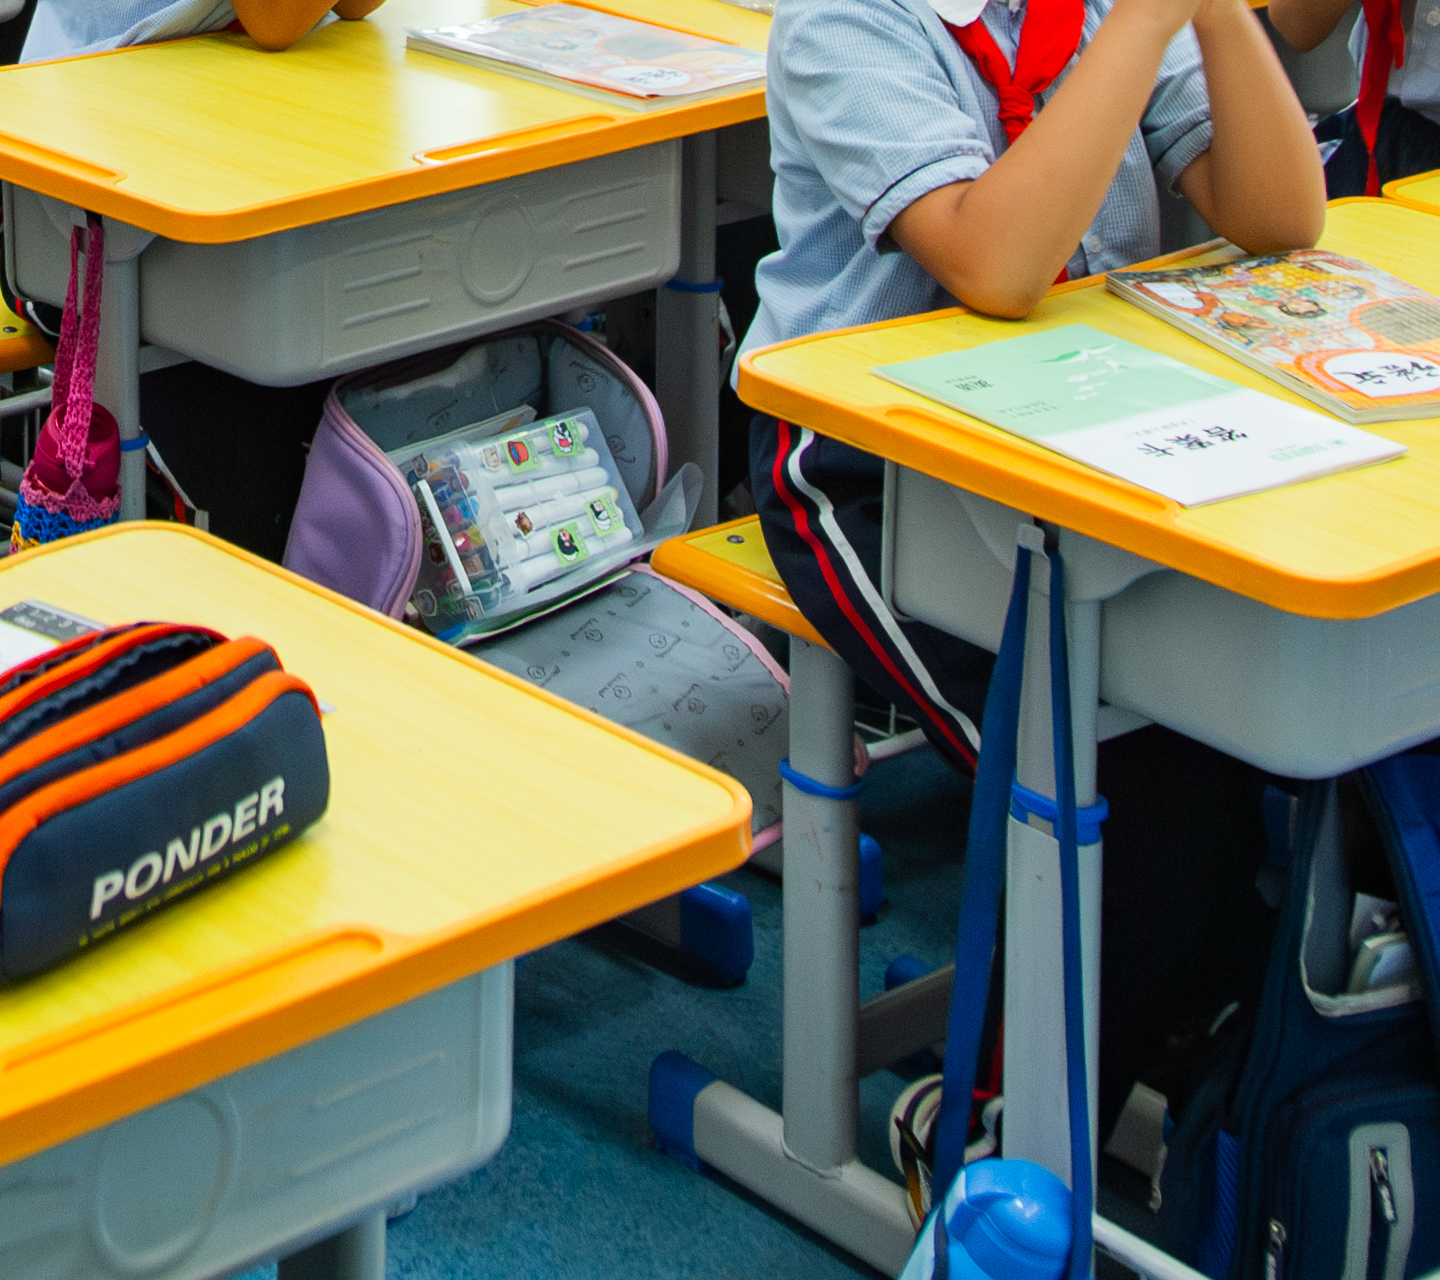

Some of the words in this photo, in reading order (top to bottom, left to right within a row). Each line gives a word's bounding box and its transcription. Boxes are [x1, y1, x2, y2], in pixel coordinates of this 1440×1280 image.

[1137, 426, 1249, 459] 答案卡
[89, 776, 287, 920] PONDER
